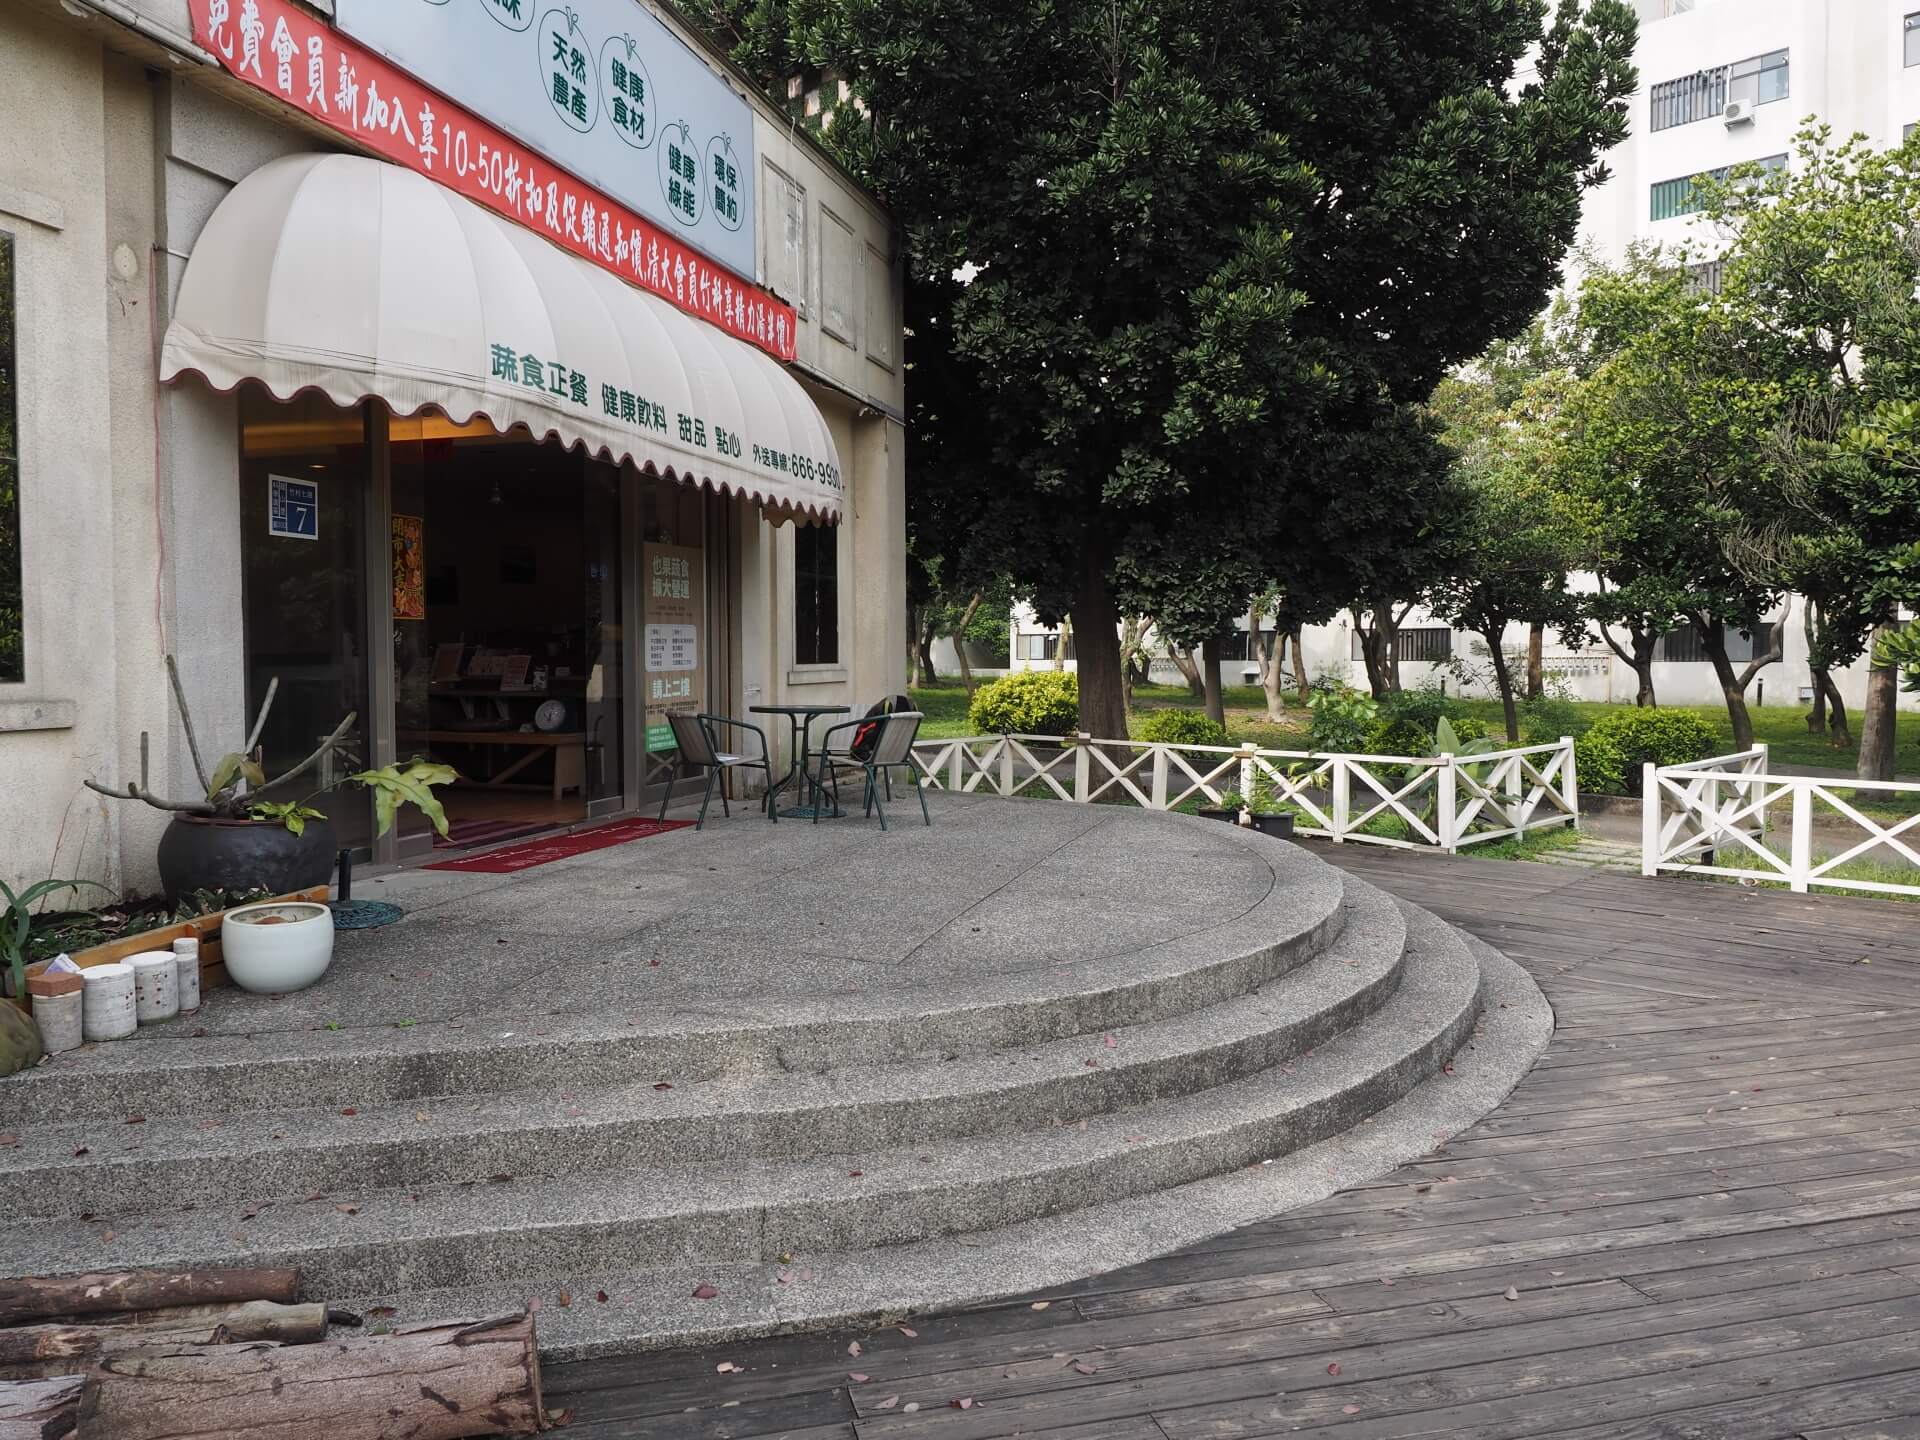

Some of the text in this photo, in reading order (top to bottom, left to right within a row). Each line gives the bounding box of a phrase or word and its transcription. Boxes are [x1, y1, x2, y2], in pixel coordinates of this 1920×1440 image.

[552, 30, 587, 86] 天然
[552, 72, 588, 125] 農產
[611, 57, 645, 107] 健康
[612, 96, 646, 141] 食材
[668, 142, 696, 188] 健康
[714, 153, 737, 193] 環保
[668, 177, 696, 218] 綠能
[714, 186, 737, 223] 簡約
[490, 343, 589, 407] 蔬食正餐
[601, 381, 668, 435] 健康飲料
[677, 413, 707, 448] 甜品
[716, 425, 741, 458] 點心
[296, 507, 308, 532] 7
